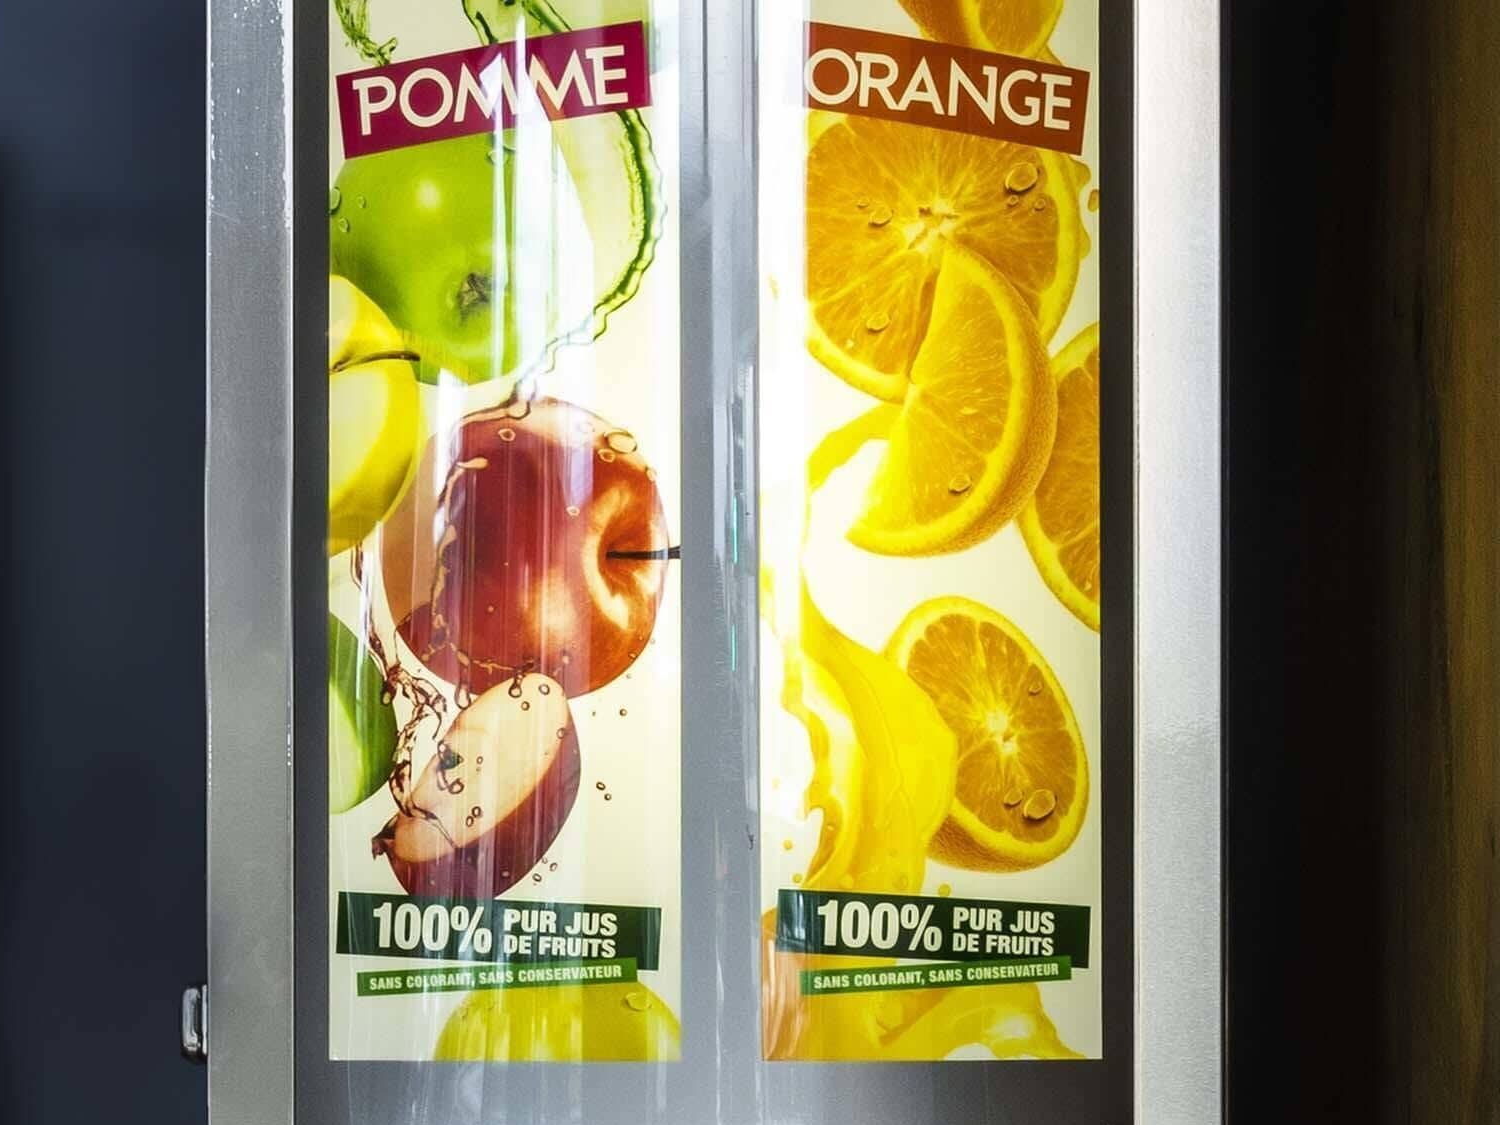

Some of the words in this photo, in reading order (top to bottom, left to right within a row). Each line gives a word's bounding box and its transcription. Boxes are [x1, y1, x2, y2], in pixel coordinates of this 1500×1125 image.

[352, 44, 629, 136] POMME
[804, 48, 1073, 131] ORANGE
[373, 902, 492, 955] 100%
[503, 909, 557, 934] PUR
[565, 911, 619, 937] JUS
[817, 900, 942, 952] 100%
[953, 906, 1002, 931] PUR
[1010, 910, 1055, 934] JUS
[952, 933, 979, 953] DE
[986, 935, 1054, 956] FRUITS
[503, 934, 531, 955] DE
[538, 936, 616, 959] FRUITS
[369, 976, 403, 991] SANS
[406, 974, 476, 989] COLORANT,
[479, 971, 514, 985] SANS
[518, 965, 622, 984] CONSERVATEUR
[813, 975, 850, 989] SANS
[854, 971, 926, 987] COLORANT,
[929, 968, 963, 983] SANS
[967, 962, 1059, 981] CONSERVATEUR
